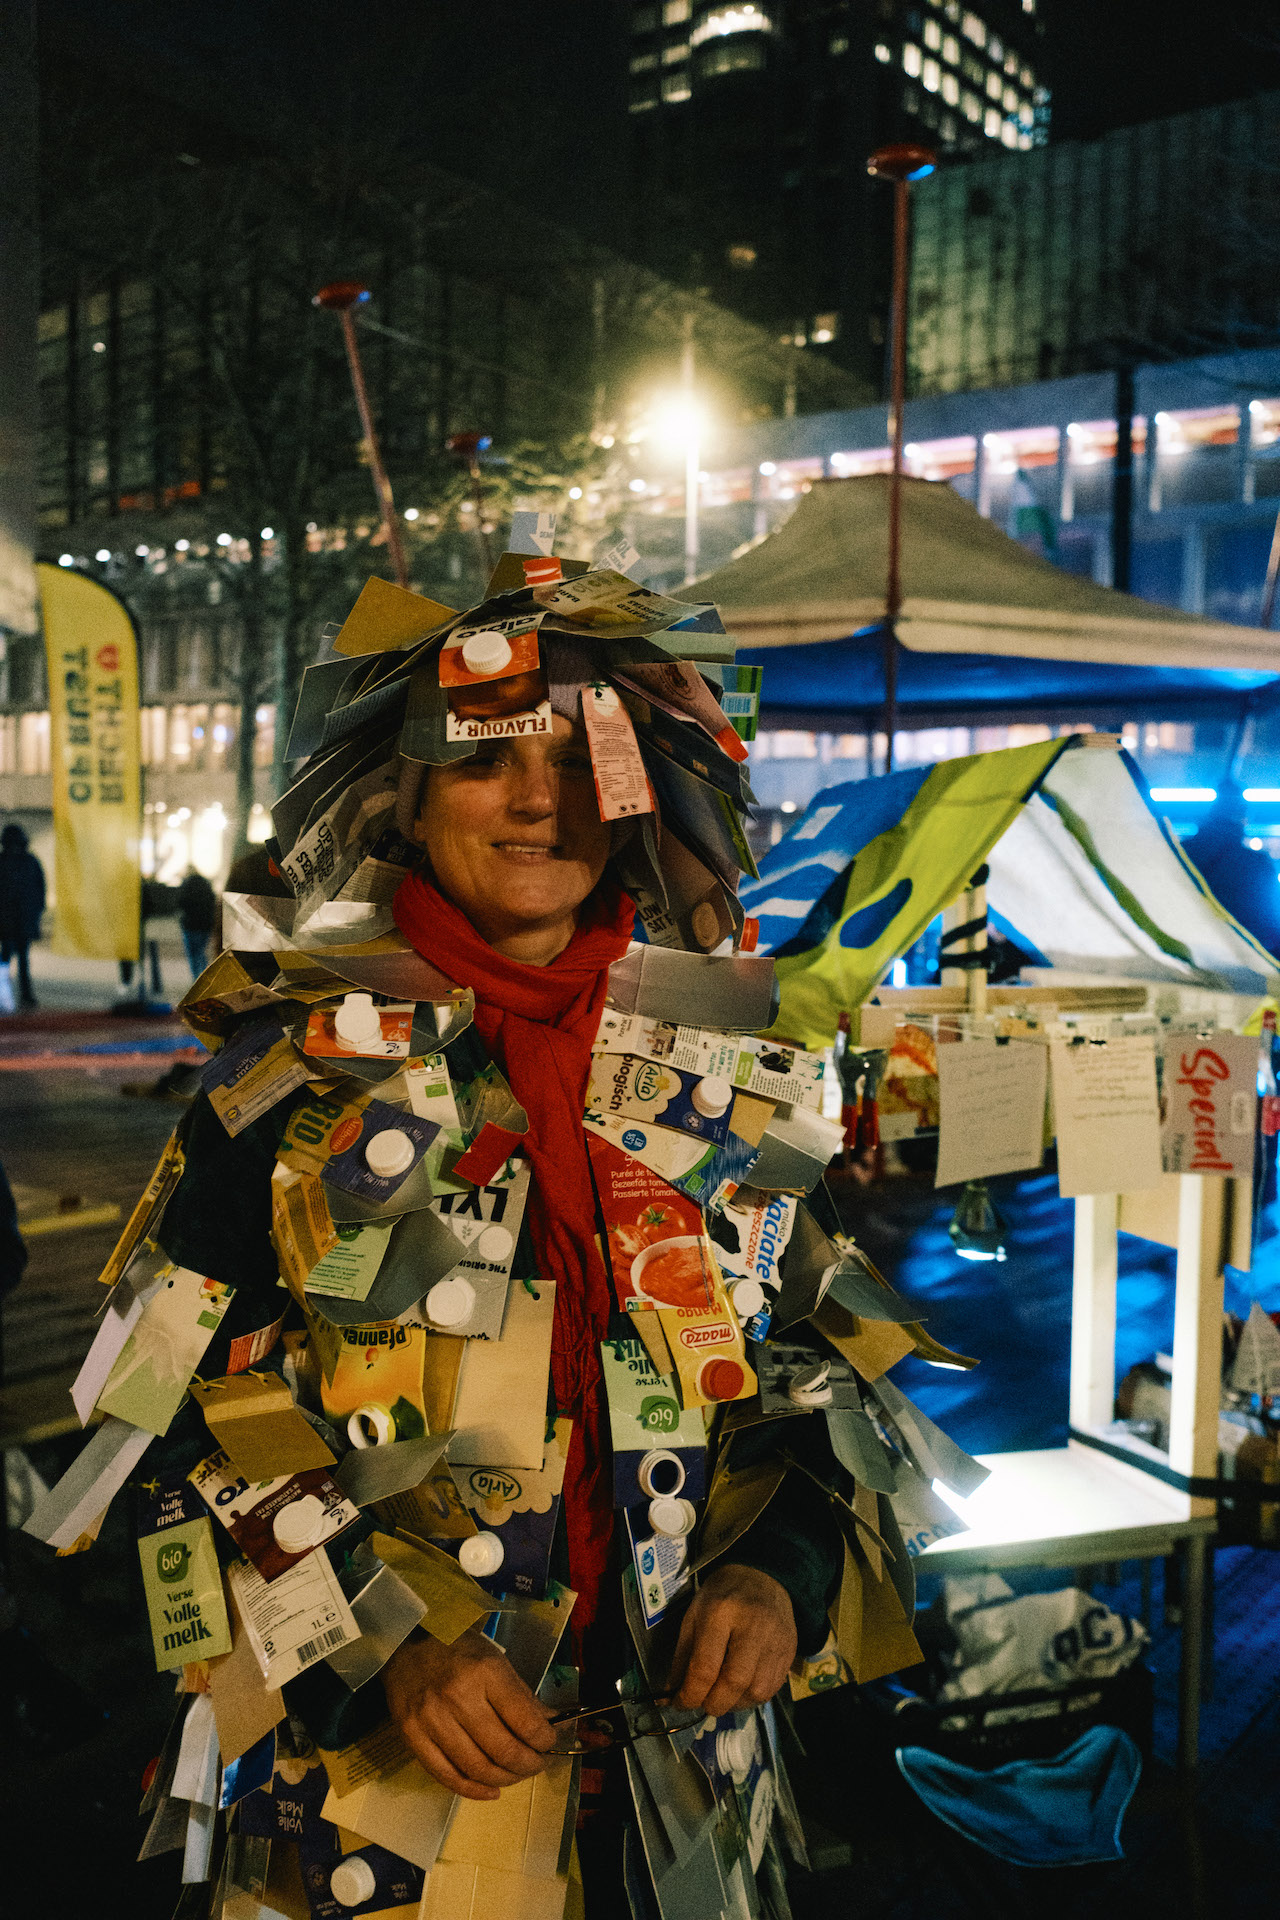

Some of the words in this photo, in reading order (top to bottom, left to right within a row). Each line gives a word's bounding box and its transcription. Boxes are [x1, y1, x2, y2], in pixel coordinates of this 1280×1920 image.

[467, 717, 547, 737] FLAVOUR
[639, 900, 663, 921] LOW
[608, 1055, 633, 1110] ologisch
[1176, 1047, 1234, 1171] Special
[611, 1169, 634, 1178] Purée
[635, 1168, 645, 1177] de
[612, 1178, 647, 1189] Gezeefde
[613, 1189, 649, 1199] Passierte
[650, 1188, 680, 1197] Tomate
[779, 1209, 791, 1237] mleko
[488, 1261, 507, 1273] THE
[676, 1302, 722, 1318] Mango
[686, 1327, 732, 1344] maaza
[649, 1408, 673, 1427] bio
[477, 1476, 514, 1497] Arla
[160, 1498, 183, 1512] Volle
[155, 1510, 186, 1527] melk
[162, 1549, 182, 1570] bio
[167, 1589, 194, 1603] Verse
[164, 1601, 201, 1624] Volle
[163, 1618, 212, 1651] melk
[276, 1799, 304, 1817] Melk
[278, 1816, 303, 1834] Volle
